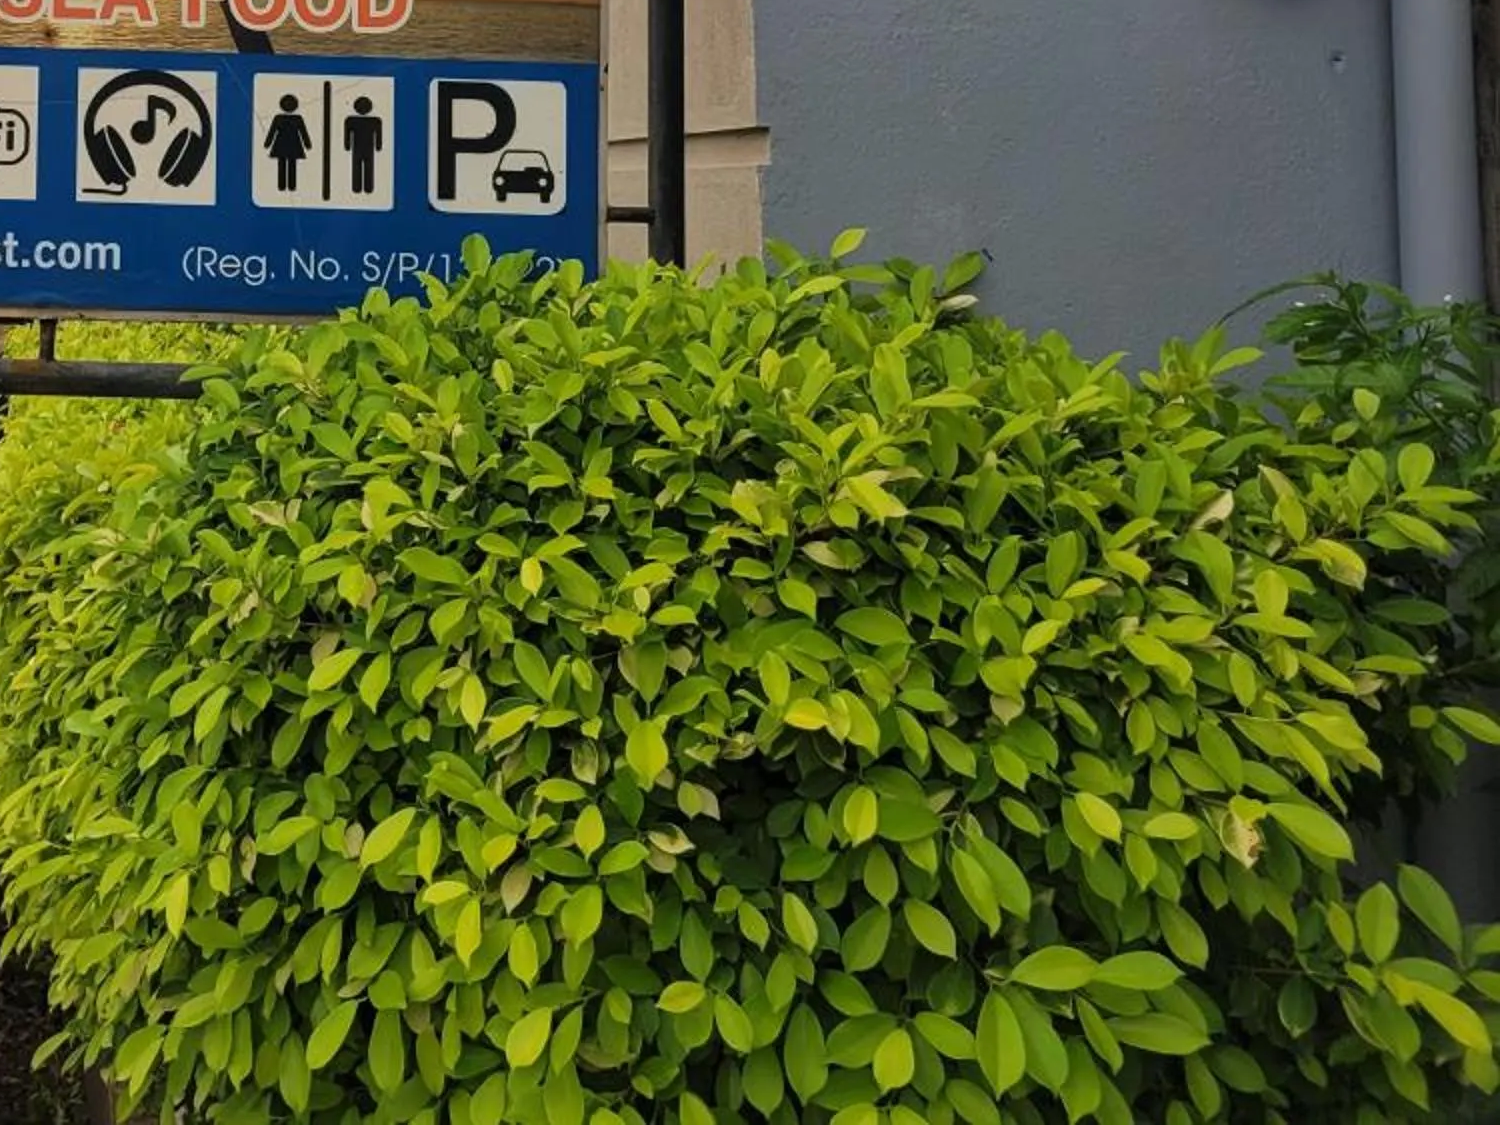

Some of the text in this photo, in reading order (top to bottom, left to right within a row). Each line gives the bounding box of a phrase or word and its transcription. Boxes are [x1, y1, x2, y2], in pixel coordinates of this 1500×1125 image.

[437, 81, 517, 200] P
[182, 246, 276, 286] (Reg.
[290, 249, 350, 281] No.
